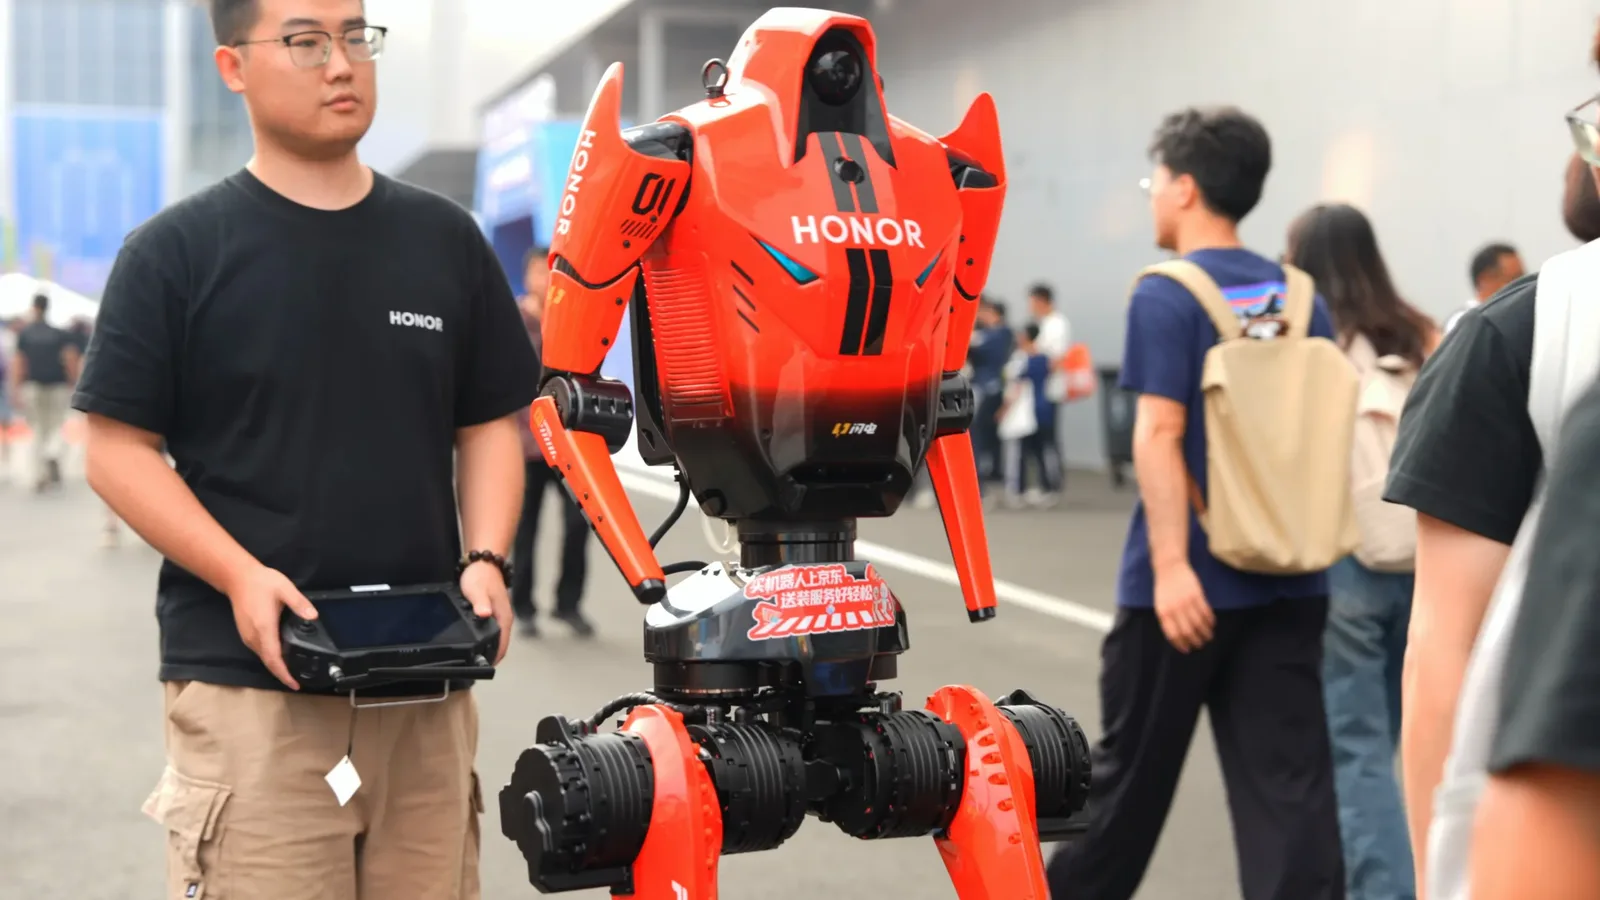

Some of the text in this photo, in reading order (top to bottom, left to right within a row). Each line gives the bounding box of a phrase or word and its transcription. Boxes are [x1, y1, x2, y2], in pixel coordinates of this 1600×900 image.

[557, 130, 596, 235] HONOR
[632, 173, 676, 216] 01
[791, 215, 925, 248] HONOR
[389, 310, 443, 332] HONOR
[750, 569, 843, 593] 买机器人上京东
[781, 585, 873, 609] 送装服务好轻松
